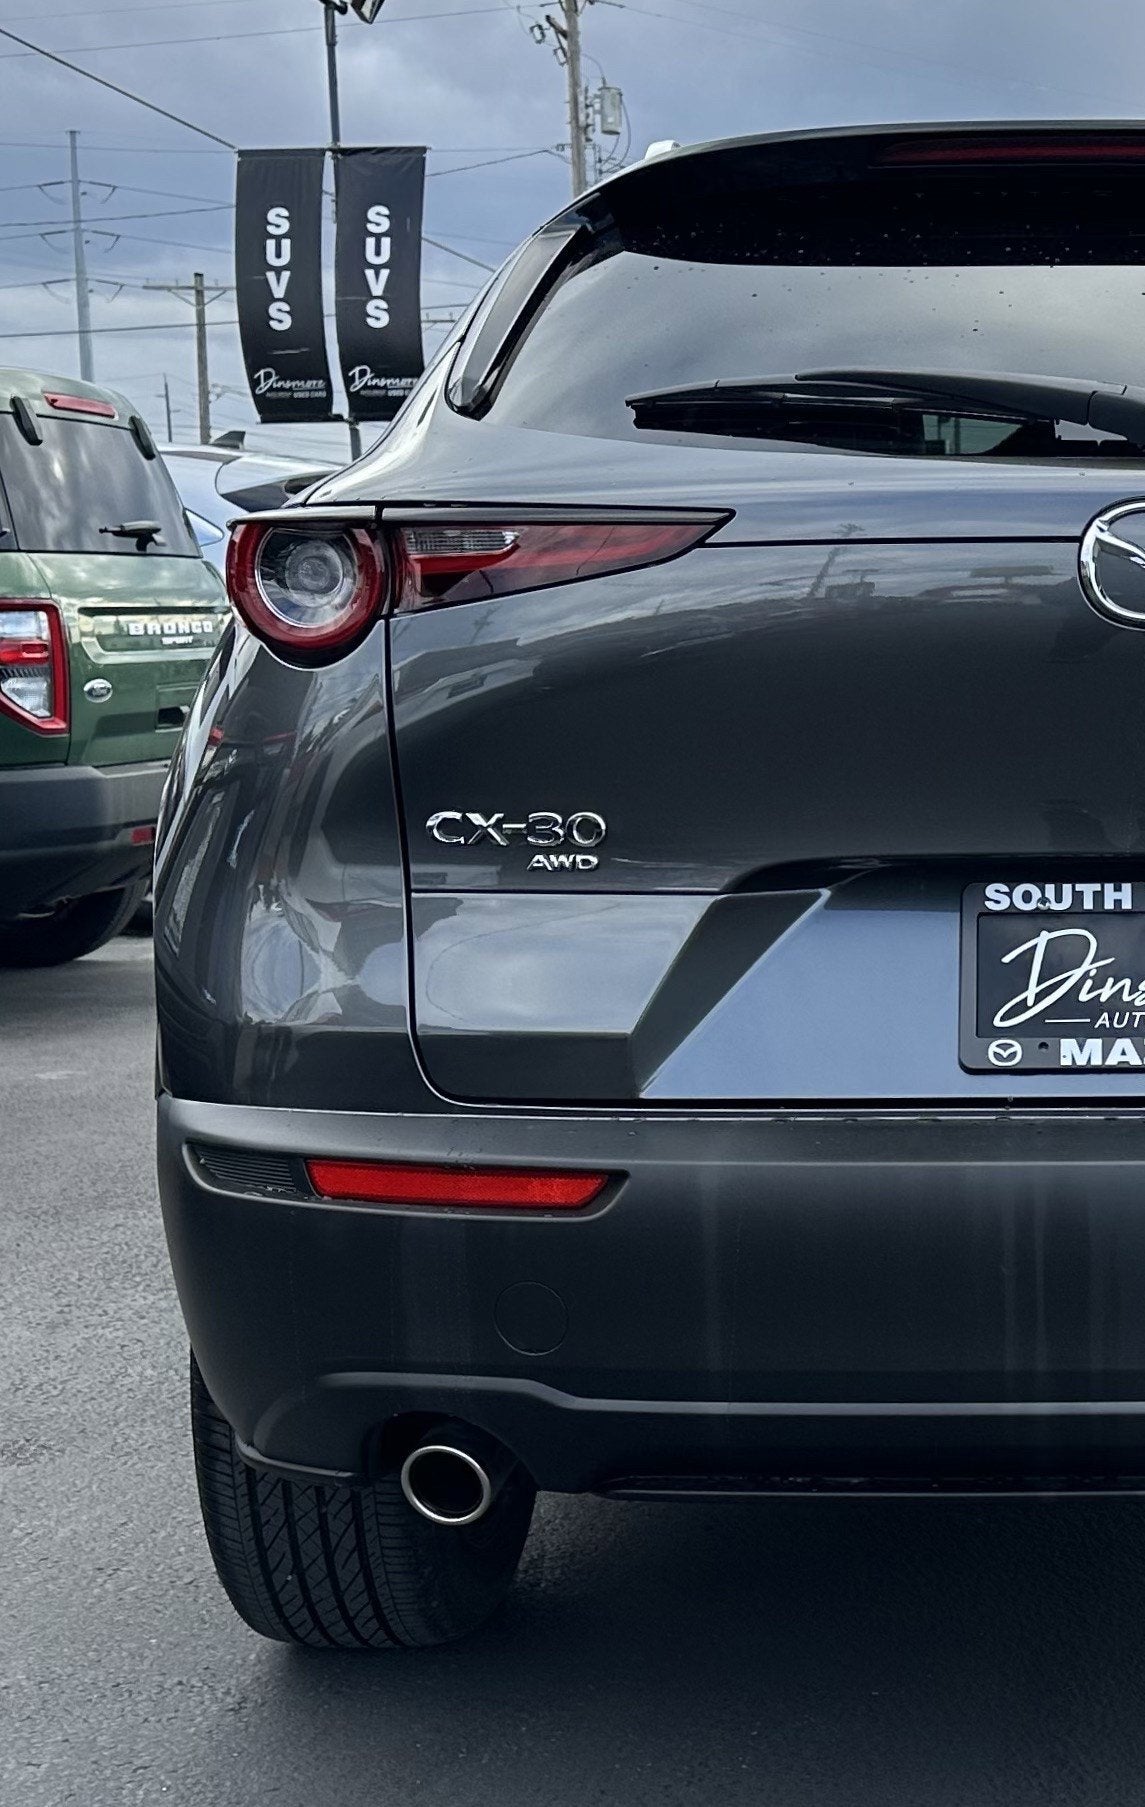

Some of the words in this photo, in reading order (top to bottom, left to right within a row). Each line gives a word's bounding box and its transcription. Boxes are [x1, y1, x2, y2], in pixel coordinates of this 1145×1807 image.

[265, 206, 292, 331] SUVS
[364, 204, 391, 329] SUVS
[253, 367, 326, 395] Dinsmore
[128, 620, 213, 636] BRONCO
[425, 810, 607, 848] CX-30
[526, 853, 599, 872] AWD
[984, 882, 1132, 912] SOUTH
